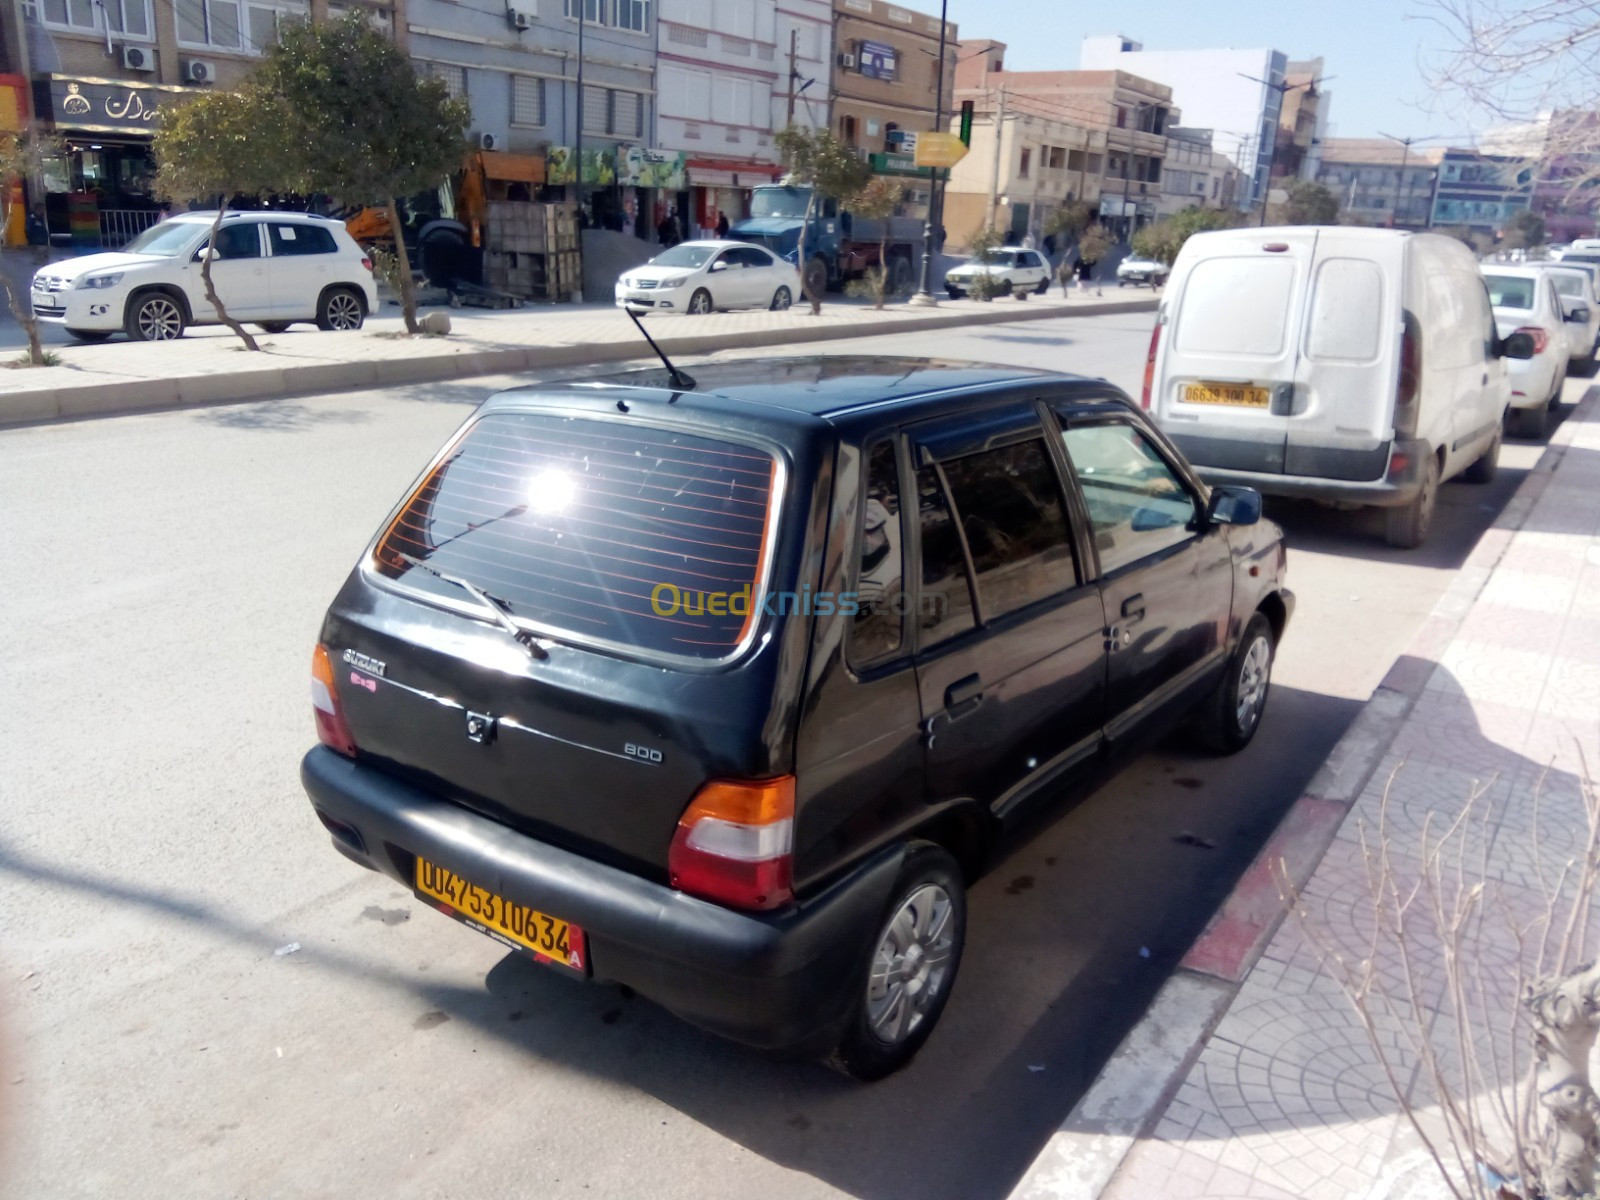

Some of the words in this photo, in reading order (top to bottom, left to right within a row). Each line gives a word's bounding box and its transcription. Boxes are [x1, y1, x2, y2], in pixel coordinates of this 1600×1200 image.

[343, 648, 386, 677] SUZUKI
[624, 743, 663, 762] 800
[569, 950, 581, 968] A
